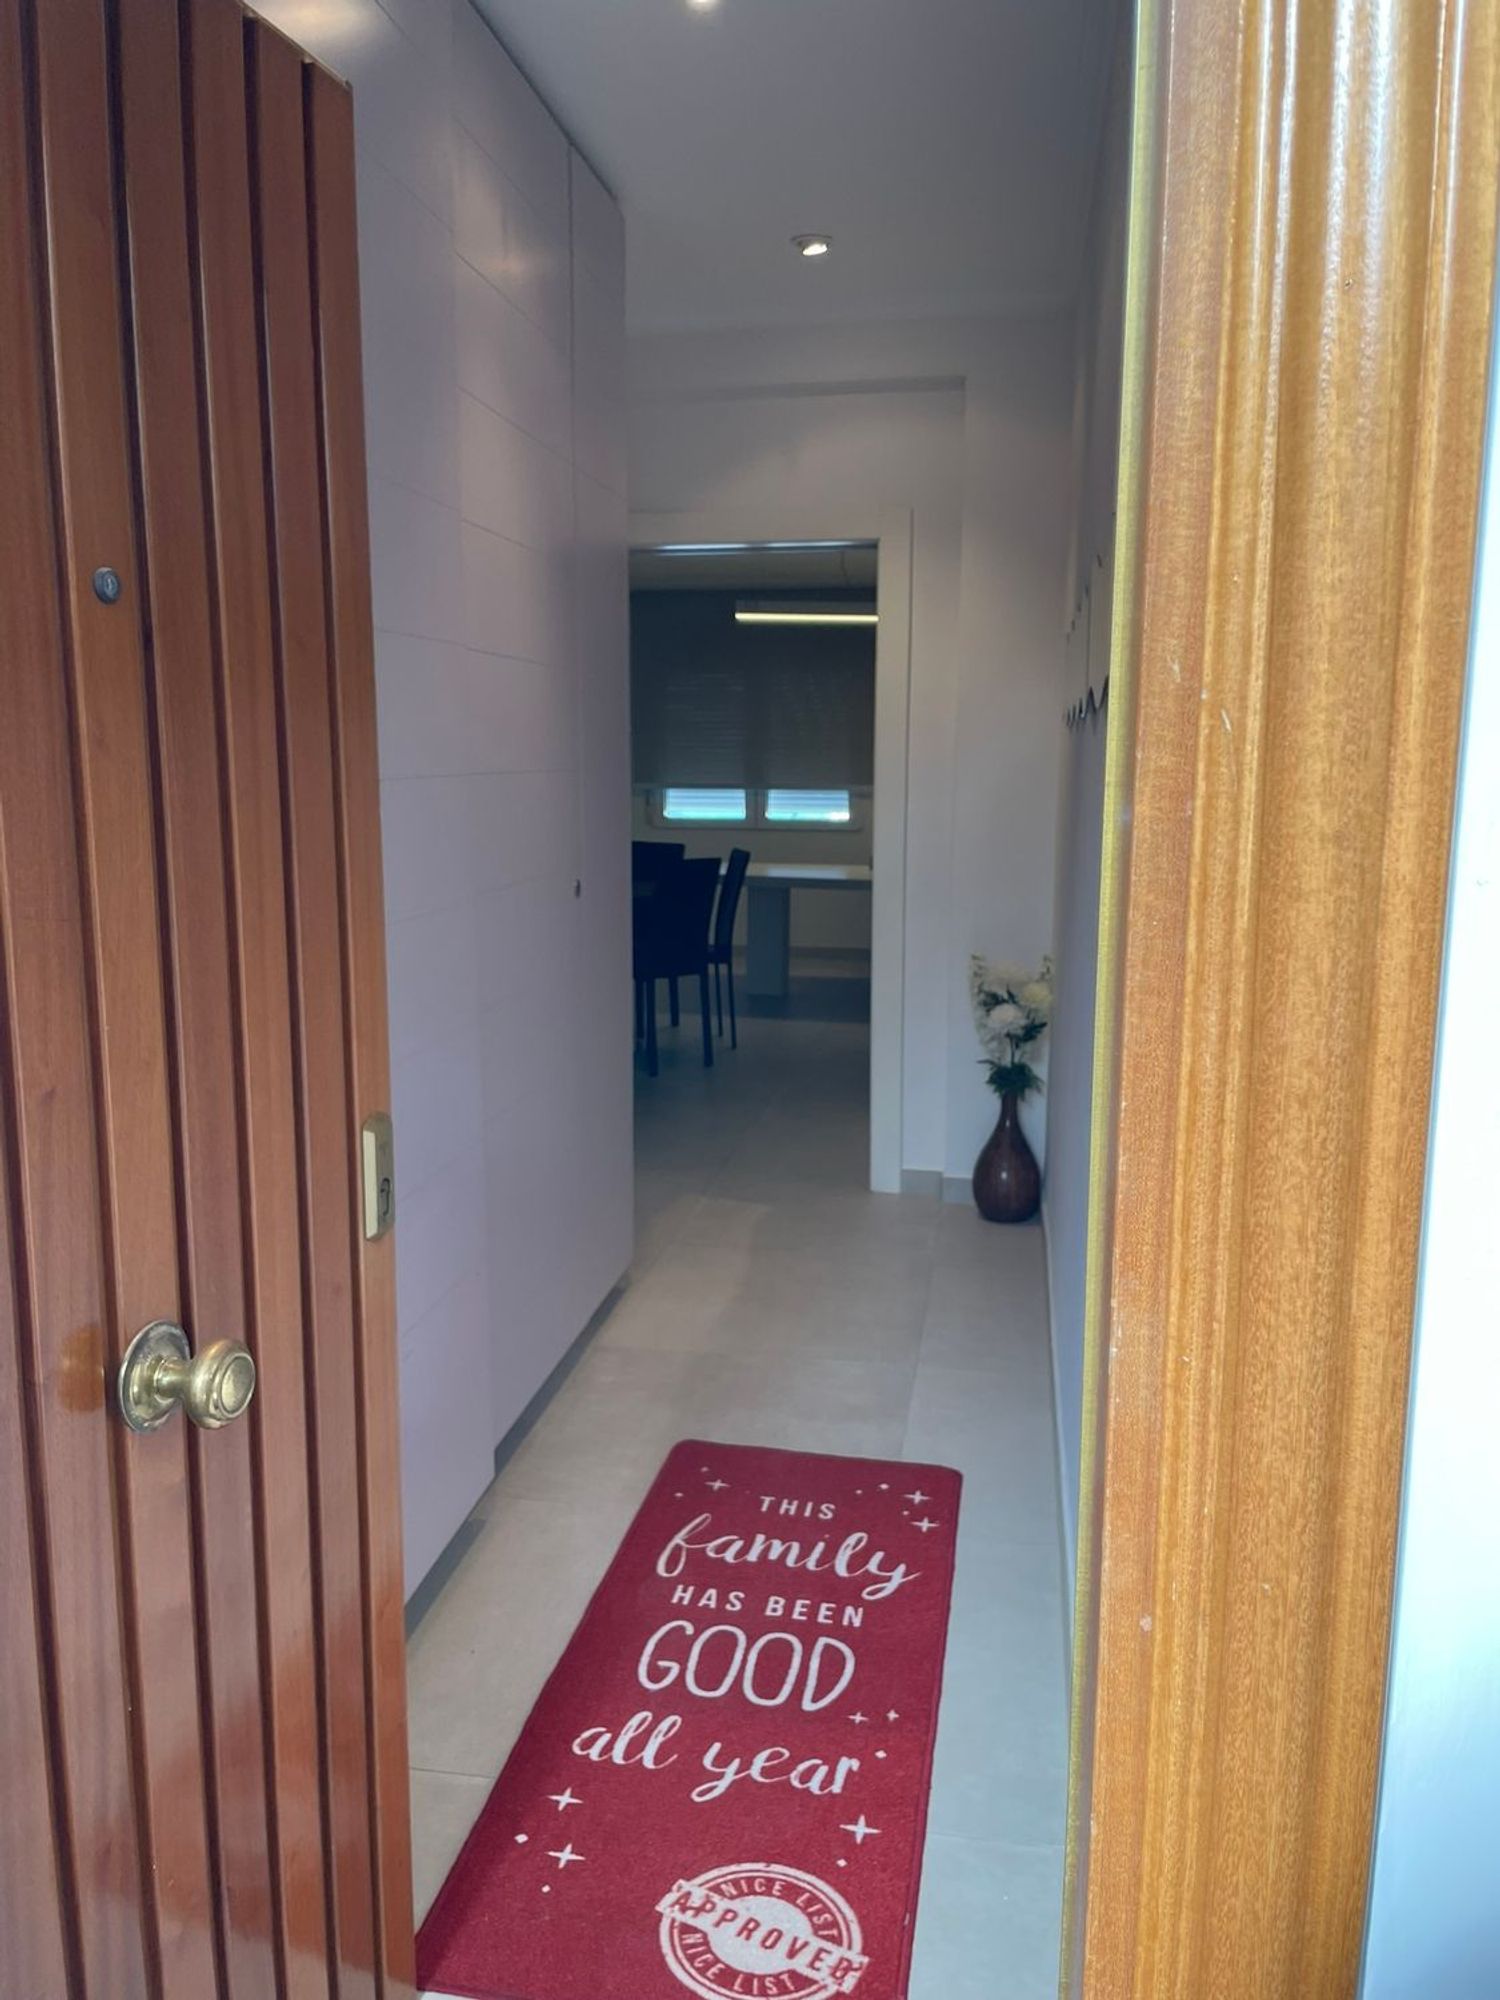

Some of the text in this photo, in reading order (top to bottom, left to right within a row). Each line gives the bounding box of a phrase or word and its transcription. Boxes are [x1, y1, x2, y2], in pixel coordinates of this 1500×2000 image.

[759, 1496, 837, 1520] THIS
[655, 1513, 921, 1600] family
[671, 1584, 865, 1628] HAS BEEN
[637, 1620, 856, 1712] GOOD
[571, 1710, 861, 1803] all year
[669, 1888, 853, 1981] APPROVED
[719, 1878, 839, 1941] NICE LIST
[681, 1932, 797, 1996] NICE LIST
